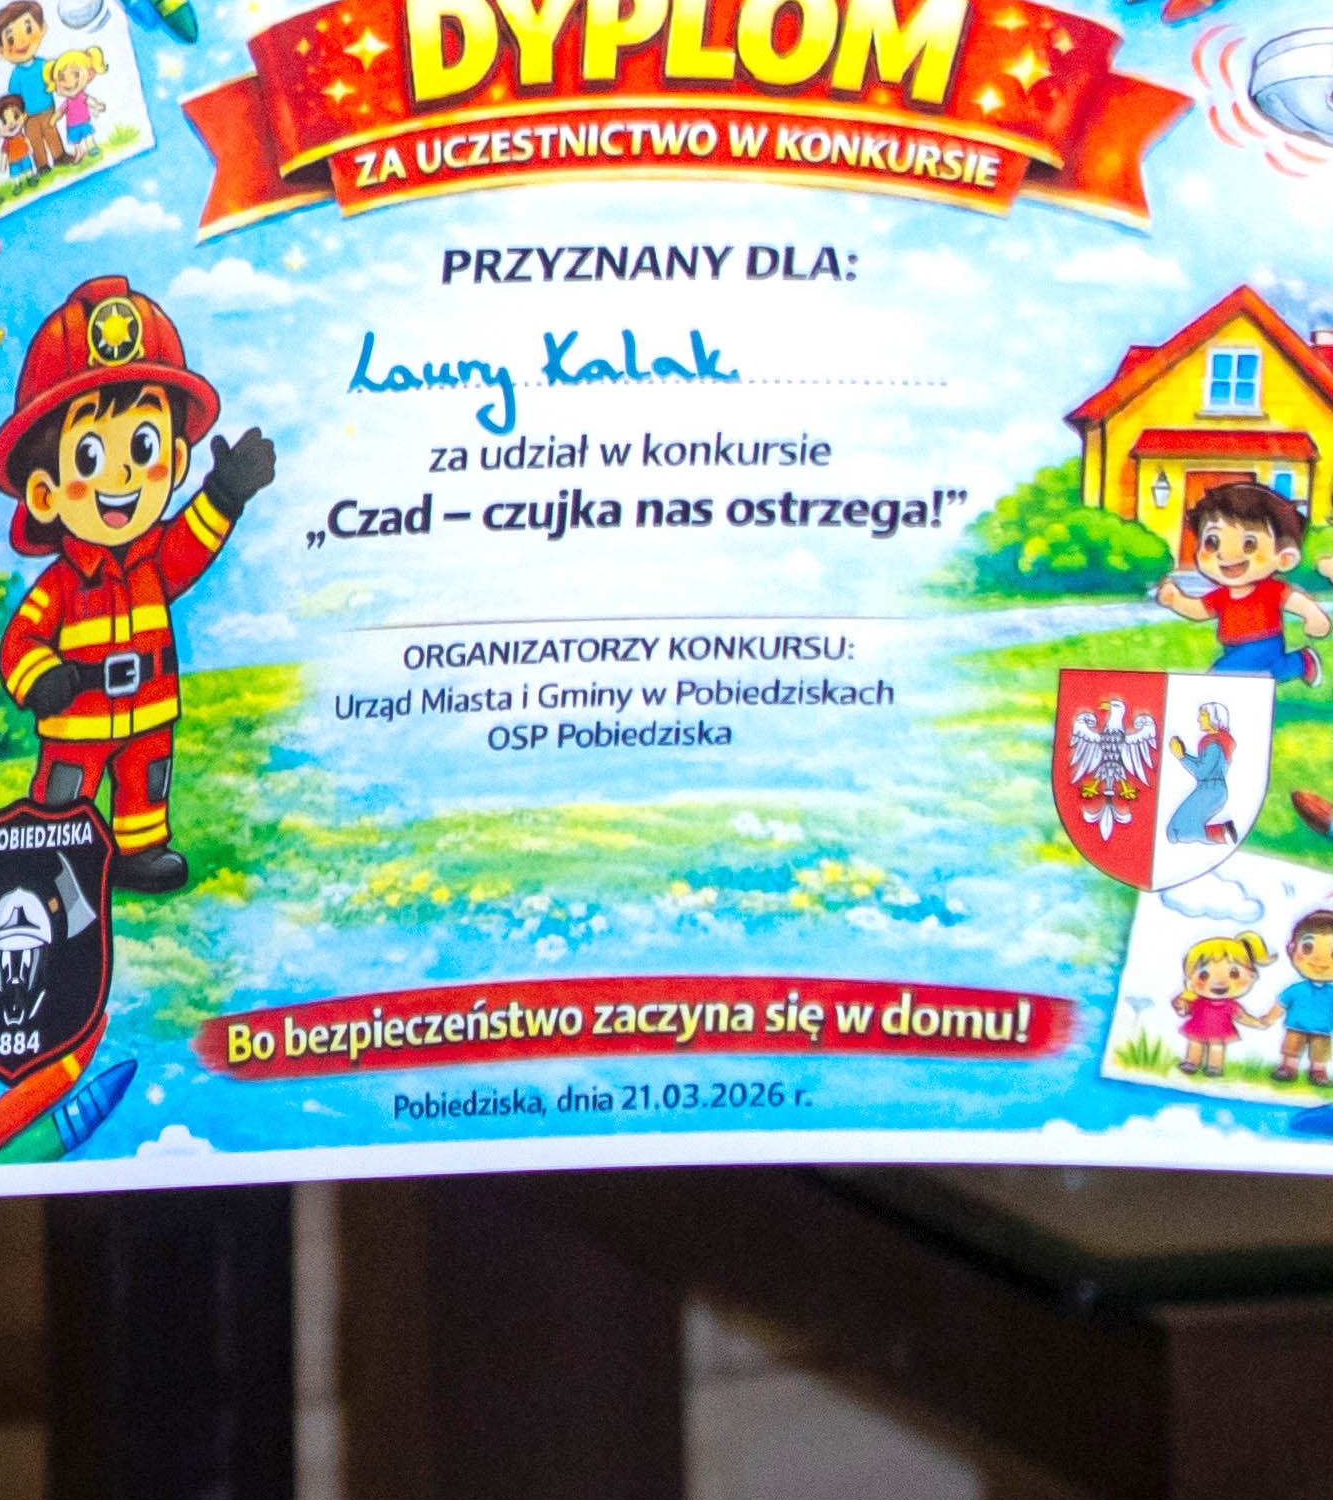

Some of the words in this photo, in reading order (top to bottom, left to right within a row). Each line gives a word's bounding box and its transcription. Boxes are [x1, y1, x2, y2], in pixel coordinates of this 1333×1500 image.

[355, 149, 406, 188] ZA
[417, 121, 718, 174] UCZESTNICTWO
[729, 126, 767, 160] W
[776, 129, 1001, 189] KONKURSIE
[441, 245, 734, 285] PRZYZNANY
[746, 245, 859, 282] DLA:
[347, 330, 517, 435] Laury
[541, 329, 740, 385] Kalak
[429, 444, 468, 473] za
[480, 432, 588, 471] udział
[601, 441, 632, 468] w
[642, 431, 832, 468] konkursie
[306, 494, 432, 550] „Czad
[482, 488, 622, 541] czujka
[635, 492, 714, 528] nas
[402, 637, 659, 670] ORGANIZATORZY
[669, 636, 855, 661] KONKURSU:
[334, 689, 412, 721] Urząd
[420, 688, 513, 715] Miasta
[521, 684, 529, 711] i
[538, 682, 633, 716] Gminy
[641, 685, 667, 708] w
[676, 679, 894, 707] Pobiedziskach
[487, 724, 548, 751] OSP
[558, 719, 733, 749] Pobiedziska
[226, 1024, 274, 1063] Bo
[284, 998, 583, 1062] bezpieczeństwo
[593, 995, 756, 1049] zaczyna
[765, 992, 823, 1041] się
[836, 1002, 874, 1036] w
[882, 992, 1031, 1043] domu!
[393, 1089, 547, 1120] Pobiedziska,
[557, 1086, 613, 1113] dnia
[621, 1082, 785, 1110] 21.03.2026
[794, 1086, 813, 1108] r.
